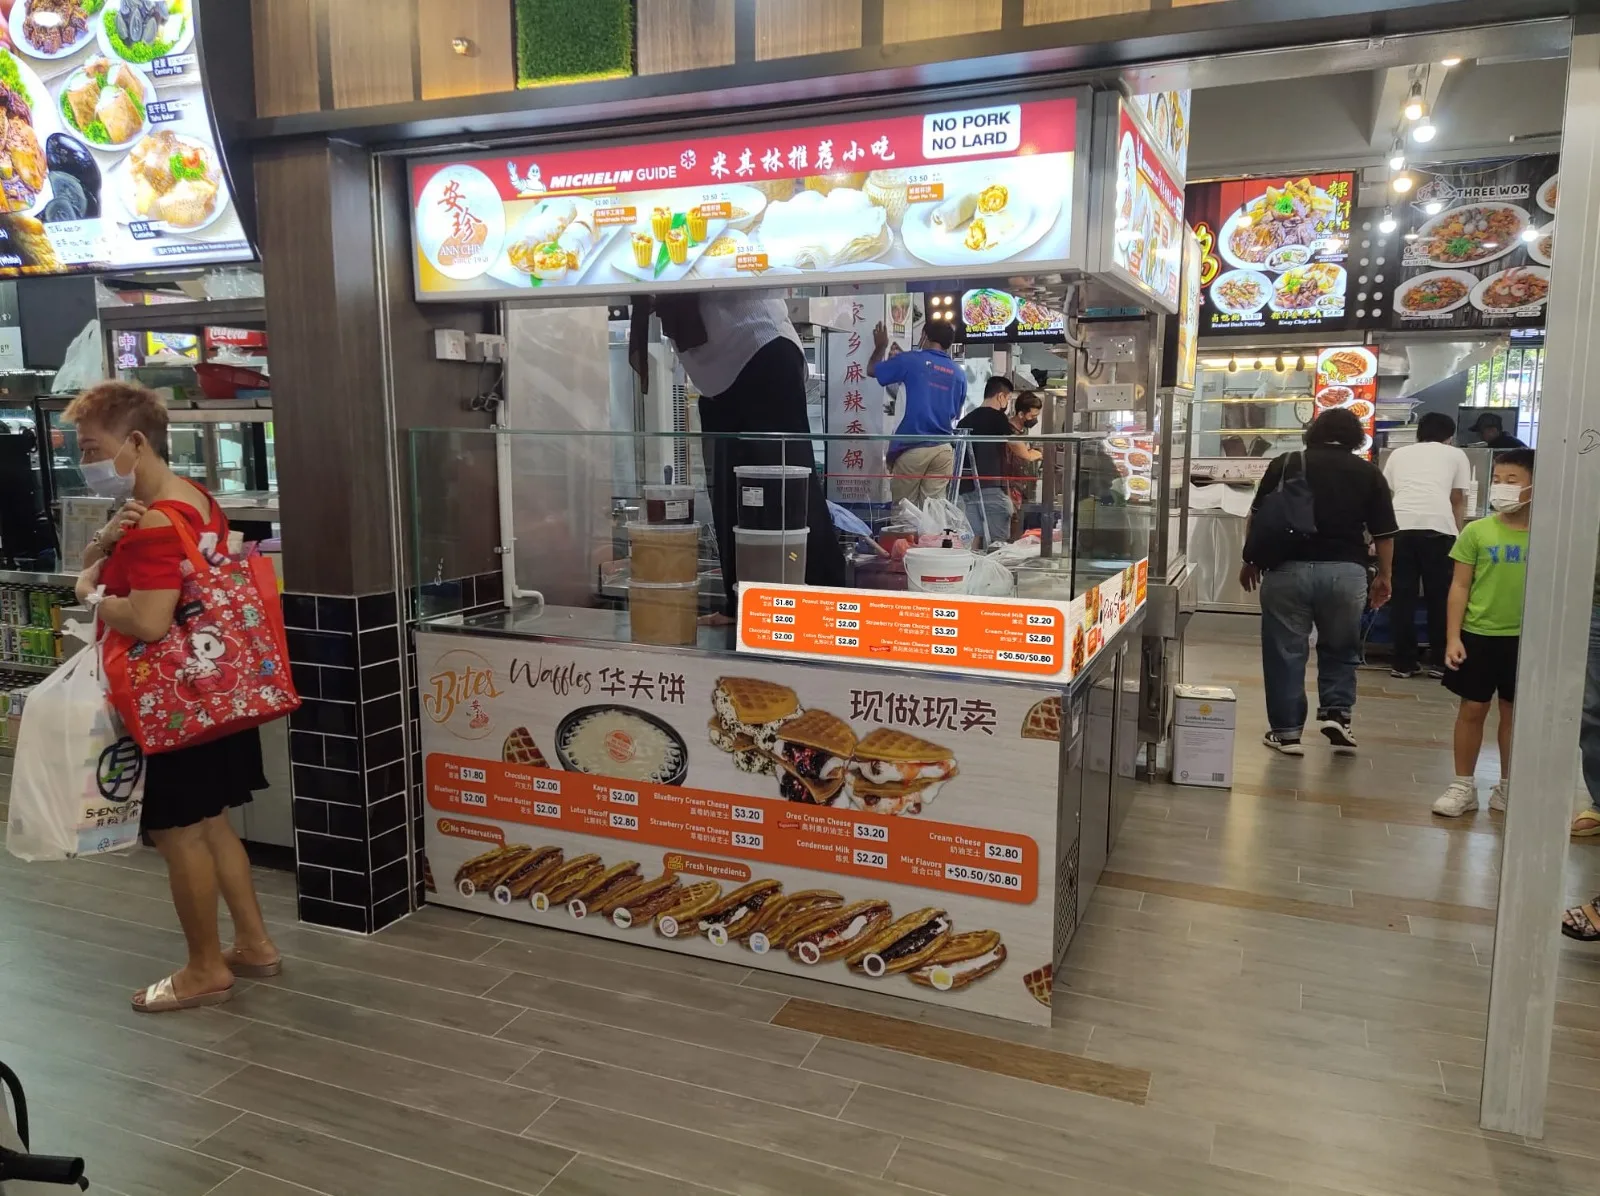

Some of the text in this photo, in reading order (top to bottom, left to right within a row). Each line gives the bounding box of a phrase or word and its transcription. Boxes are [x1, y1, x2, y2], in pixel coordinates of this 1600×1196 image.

[932, 110, 1011, 132] NO PORK
[932, 130, 1007, 151] NO LARD
[709, 135, 896, 178] 米其林推荐小吃
[550, 165, 677, 188] MICHELIN GUIDE
[1457, 185, 1528, 198] THREE WOK
[437, 180, 482, 242] 安珍
[440, 245, 459, 256] ANN
[1487, 544, 1526, 564] YM
[775, 599, 794, 607] $1.80
[838, 603, 858, 612] $2.00
[774, 615, 793, 624] $2.00
[934, 609, 956, 618] $3.20
[1029, 616, 1052, 625] $2.20
[838, 619, 857, 629] $2.00
[934, 627, 956, 636] $3.20
[774, 632, 793, 641] $2.00
[837, 637, 857, 646] $2.80
[1028, 634, 1052, 643] $2.80
[933, 645, 955, 655] $3.20
[998, 651, 1052, 664] +$0.50/$0.80
[509, 656, 592, 696] Waffles
[598, 666, 686, 704] 华夫饼
[423, 666, 504, 724] Bites
[849, 689, 998, 736] 现做现卖
[463, 769, 484, 781] $1.80
[504, 771, 558, 791] Chocolate $2.00
[464, 793, 485, 804] $2.00
[592, 784, 636, 803] Kaya $2.00
[493, 794, 558, 815] Peanut Butter $2.00
[653, 792, 760, 821] BlueBerry Cream Cheese $3.20
[570, 805, 636, 828] Lotus Biscoff $2.80
[786, 811, 885, 839] Oreo Cream Cheese $3.20
[450, 824, 503, 841] No Preservatives
[650, 817, 761, 847] Strawberry Cream Cheese $3.20
[796, 839, 884, 866] Condensed Milk $2.20
[929, 832, 1019, 860] Cream Cheese $2.80
[685, 860, 747, 878] Fresh Ingredients
[900, 855, 1019, 887] Mix Flavors +$0.50/$0.80
